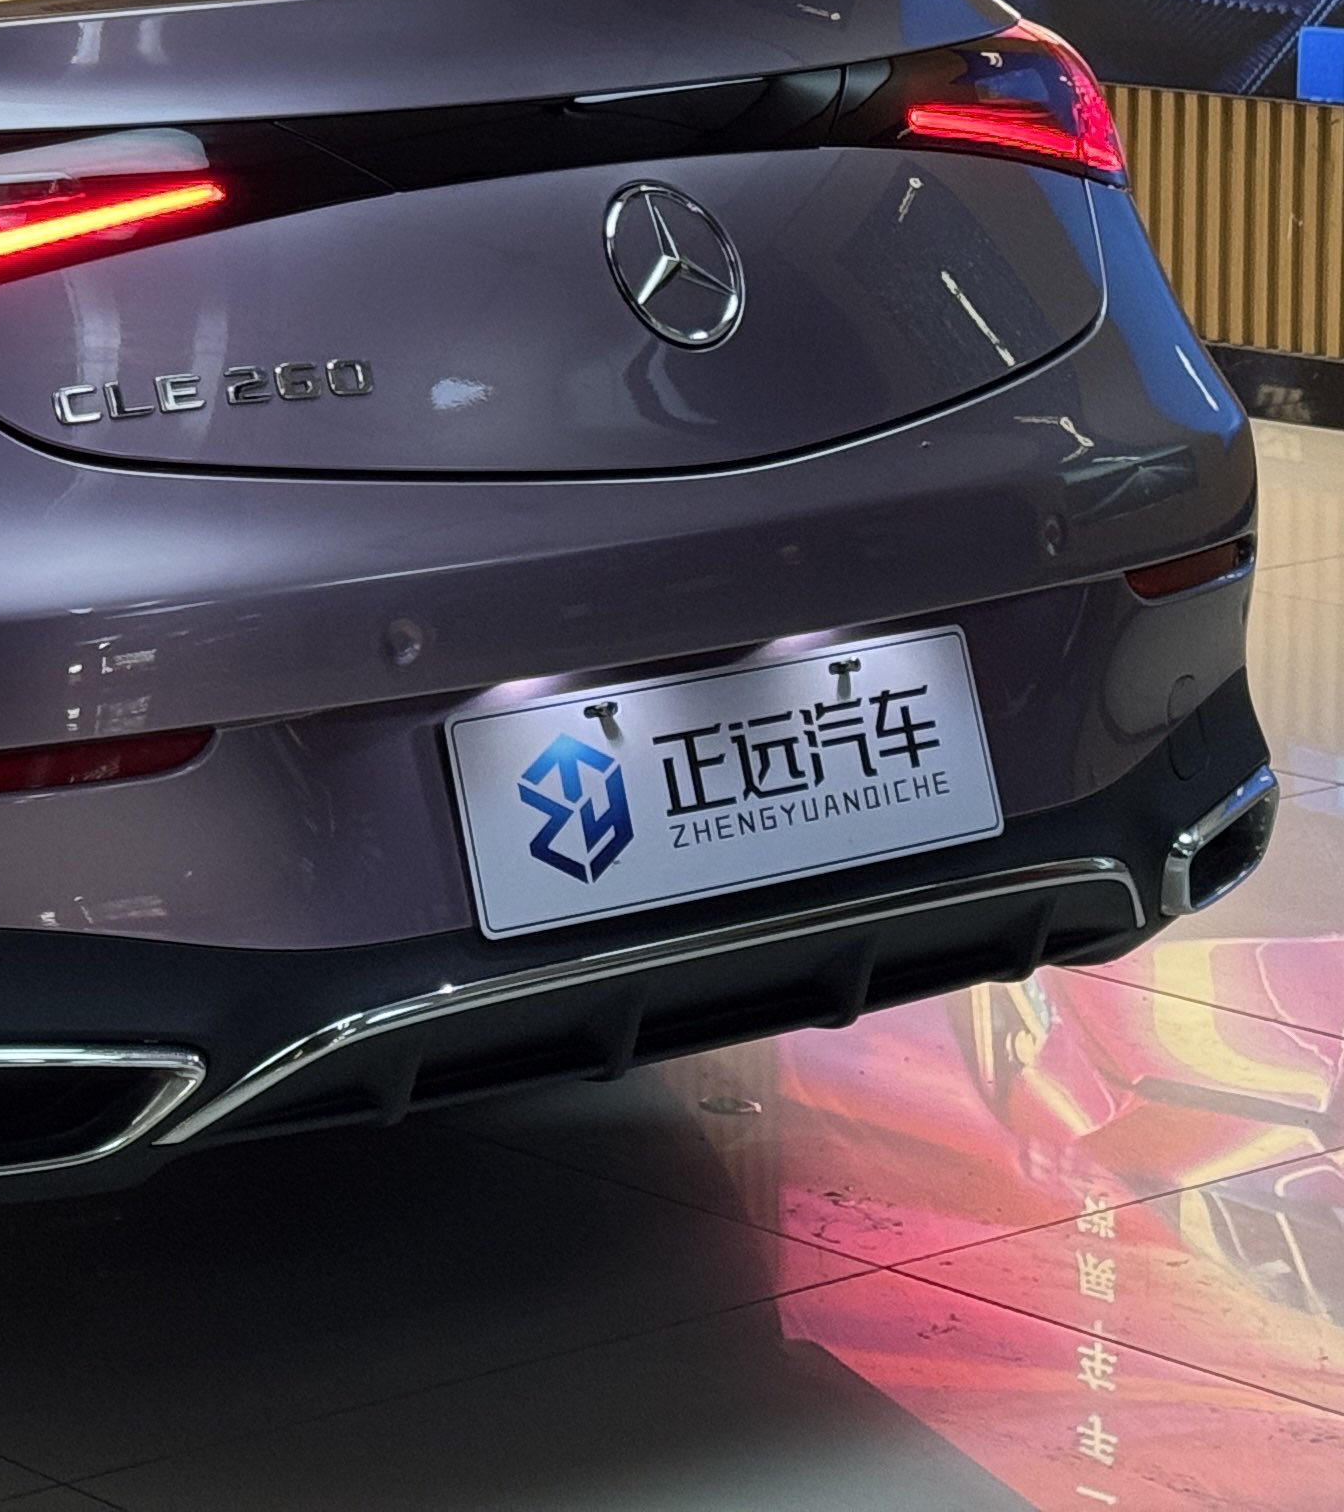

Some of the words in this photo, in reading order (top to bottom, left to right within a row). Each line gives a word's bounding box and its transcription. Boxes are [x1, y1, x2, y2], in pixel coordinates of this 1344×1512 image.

[52, 373, 207, 425] CLE
[223, 359, 375, 405] 260
[652, 684, 941, 817] 正远汽车
[668, 771, 951, 849] ZHENGYUANQICHE
